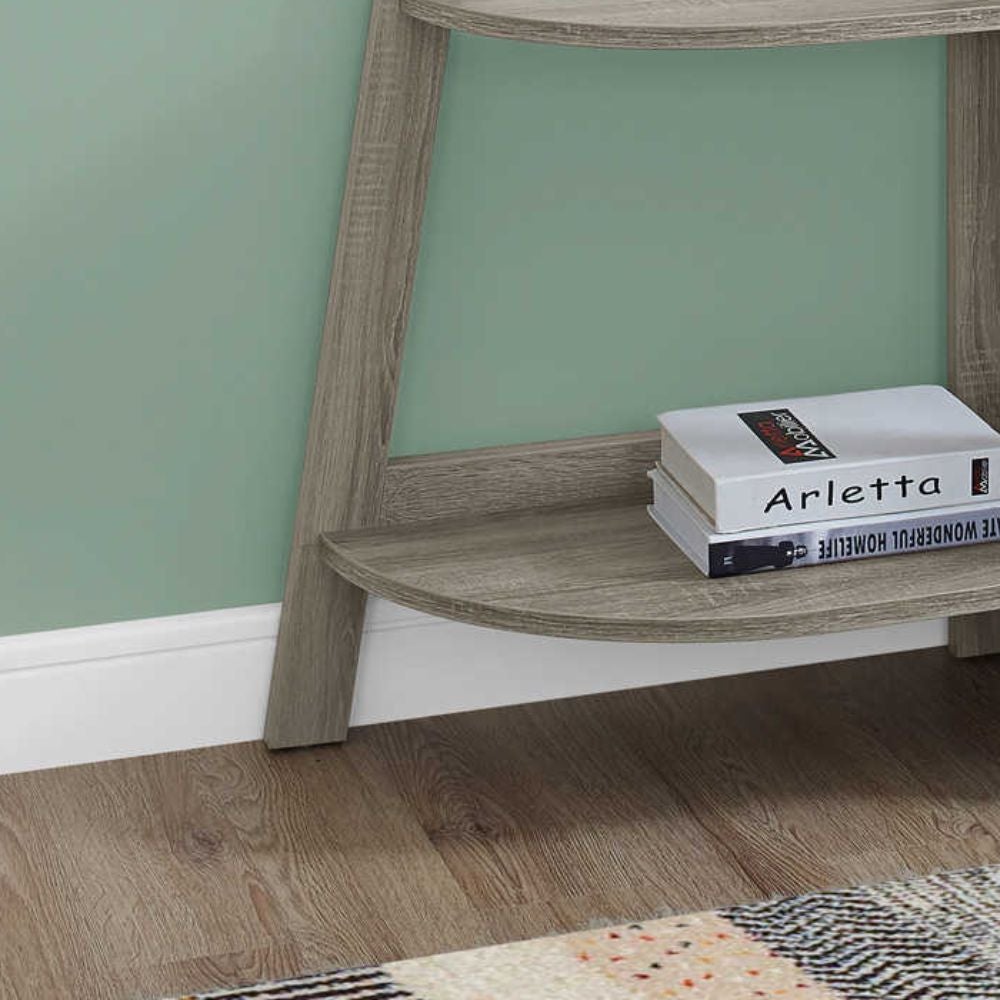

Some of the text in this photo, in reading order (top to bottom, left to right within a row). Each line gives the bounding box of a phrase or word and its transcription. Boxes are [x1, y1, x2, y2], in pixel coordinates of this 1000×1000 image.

[764, 474, 941, 513] Arletta
[818, 532, 887, 559] HOMELIFE
[892, 520, 978, 550] WONDERFUL
